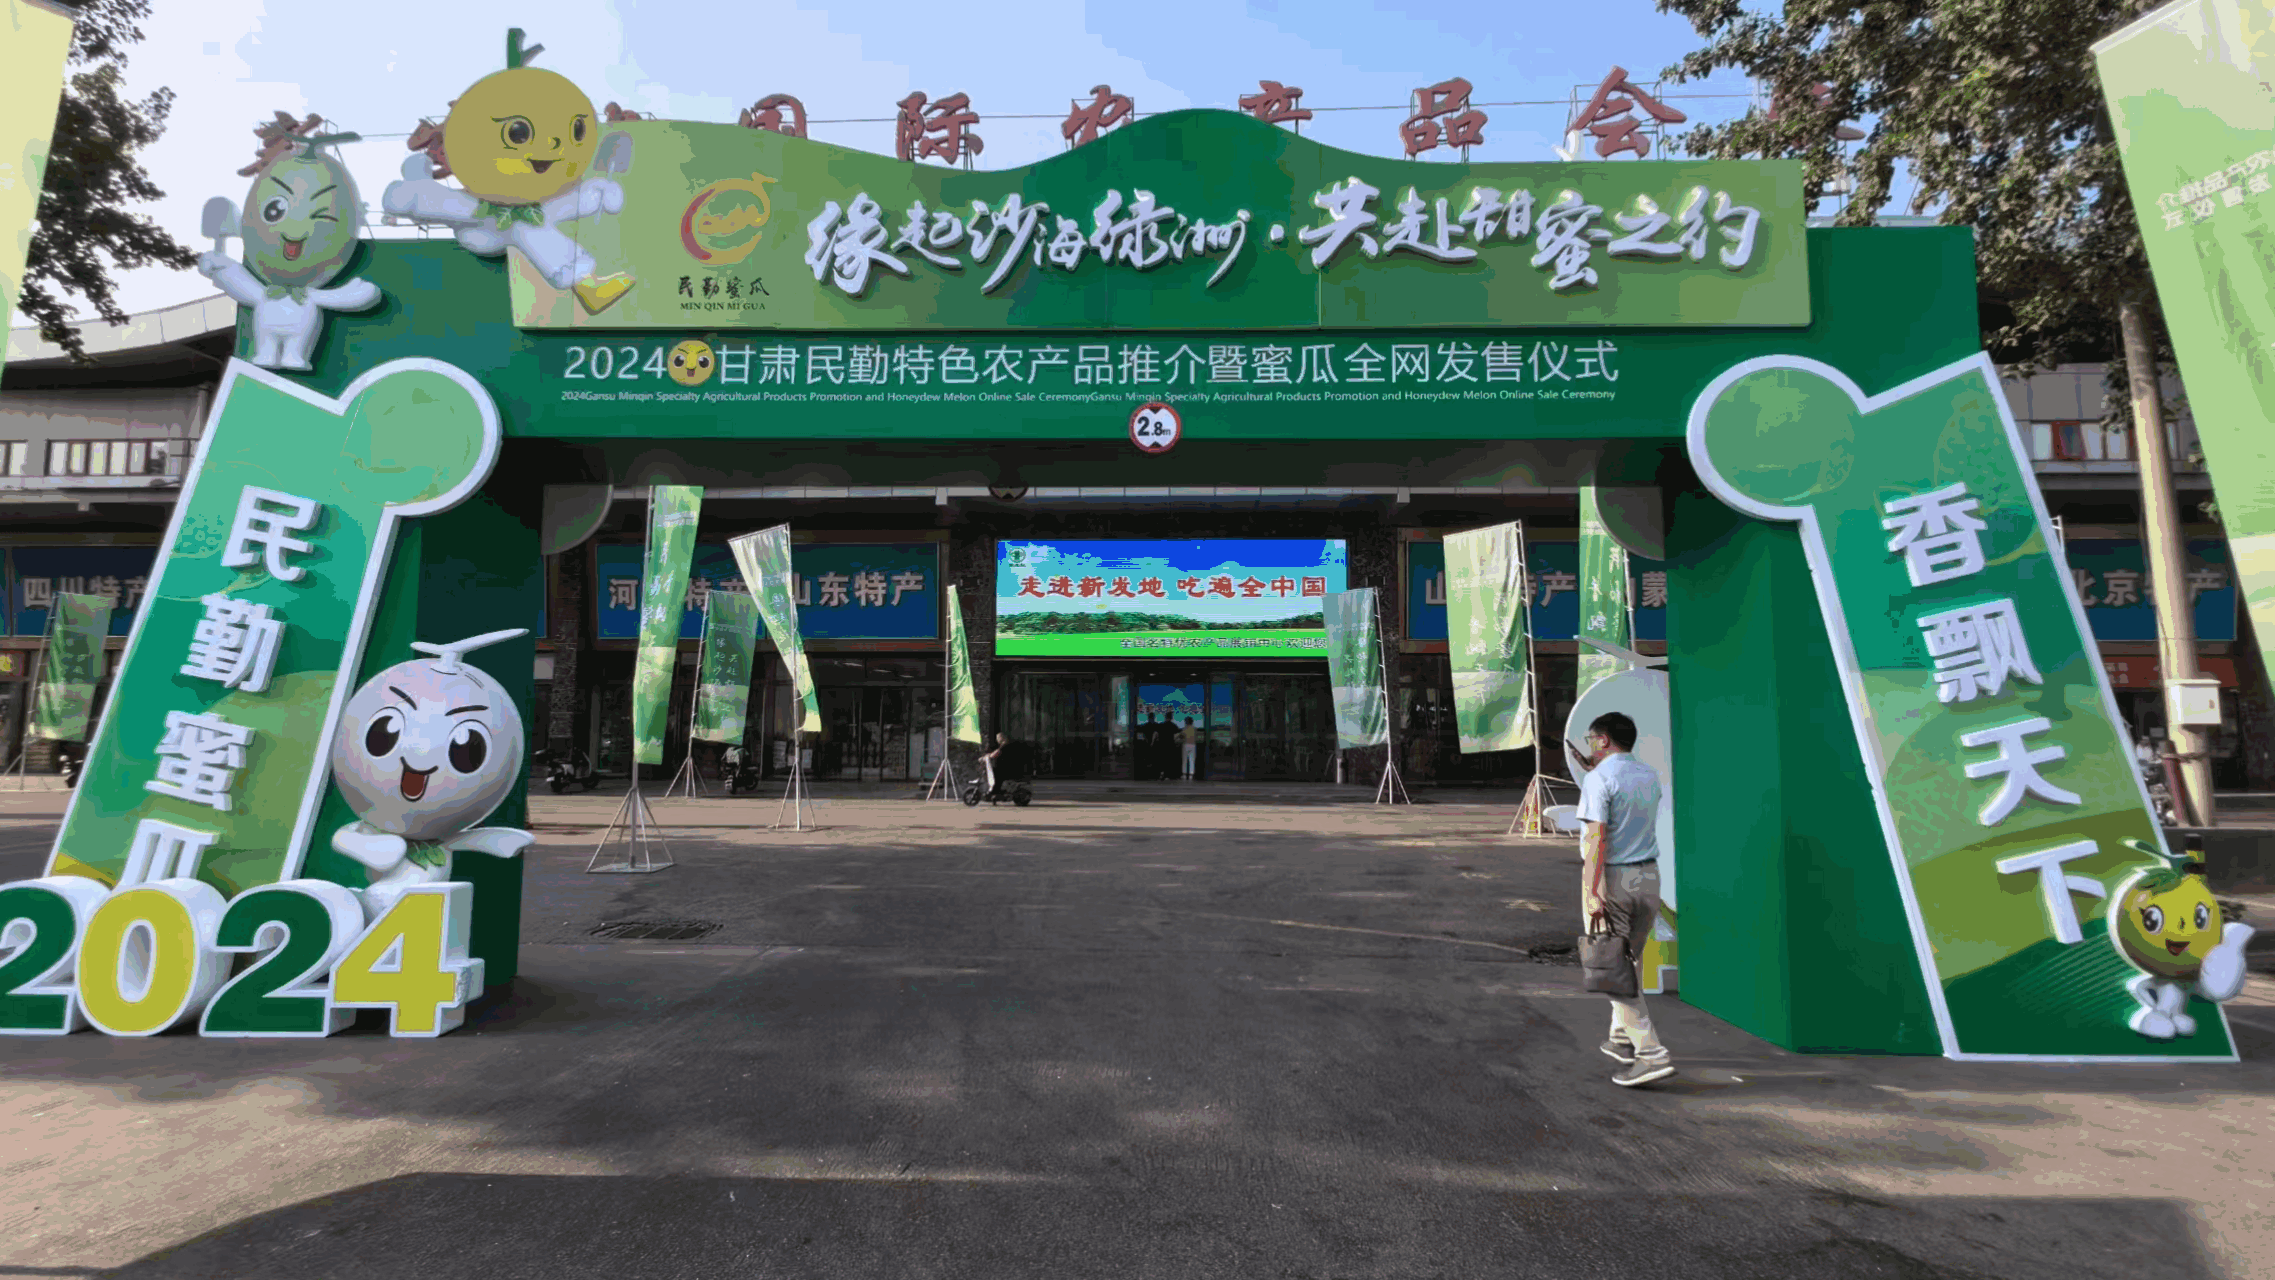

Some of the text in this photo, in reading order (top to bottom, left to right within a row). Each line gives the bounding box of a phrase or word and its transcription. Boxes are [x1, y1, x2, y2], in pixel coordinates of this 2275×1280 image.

[678, 275, 770, 300] 民勤蜜瓜
[680, 302, 766, 312] MIN QIN MI GUA
[656, 391, 700, 402] Specialty
[703, 391, 761, 402] Agricultural
[763, 391, 807, 401] Products
[810, 391, 863, 401] Promotion
[865, 392, 885, 401] and
[887, 391, 941, 403] Honeydew
[943, 391, 976, 401] Melon
[978, 391, 1012, 401] Online
[1014, 391, 1036, 401] Sale
[1164, 391, 1209, 403] Specialty
[1213, 391, 1273, 403] Agricultural
[1276, 391, 1321, 401] Products
[1324, 390, 1379, 401] Promotion
[1381, 390, 1401, 401] and
[1404, 390, 1460, 402] Honeydew
[1463, 389, 1497, 400] Melon
[1499, 389, 1534, 400] Online
[1537, 389, 1559, 400] Sale
[1561, 389, 1616, 402] Ceremony
[792, 571, 925, 608] 山东特产
[1018, 575, 1327, 598] 走进新发地 吃遍全中国
[2072, 567, 2222, 608] 北京产
[1881, 481, 2108, 945] 香飘天下
[0, 876, 482, 1038] 2024
